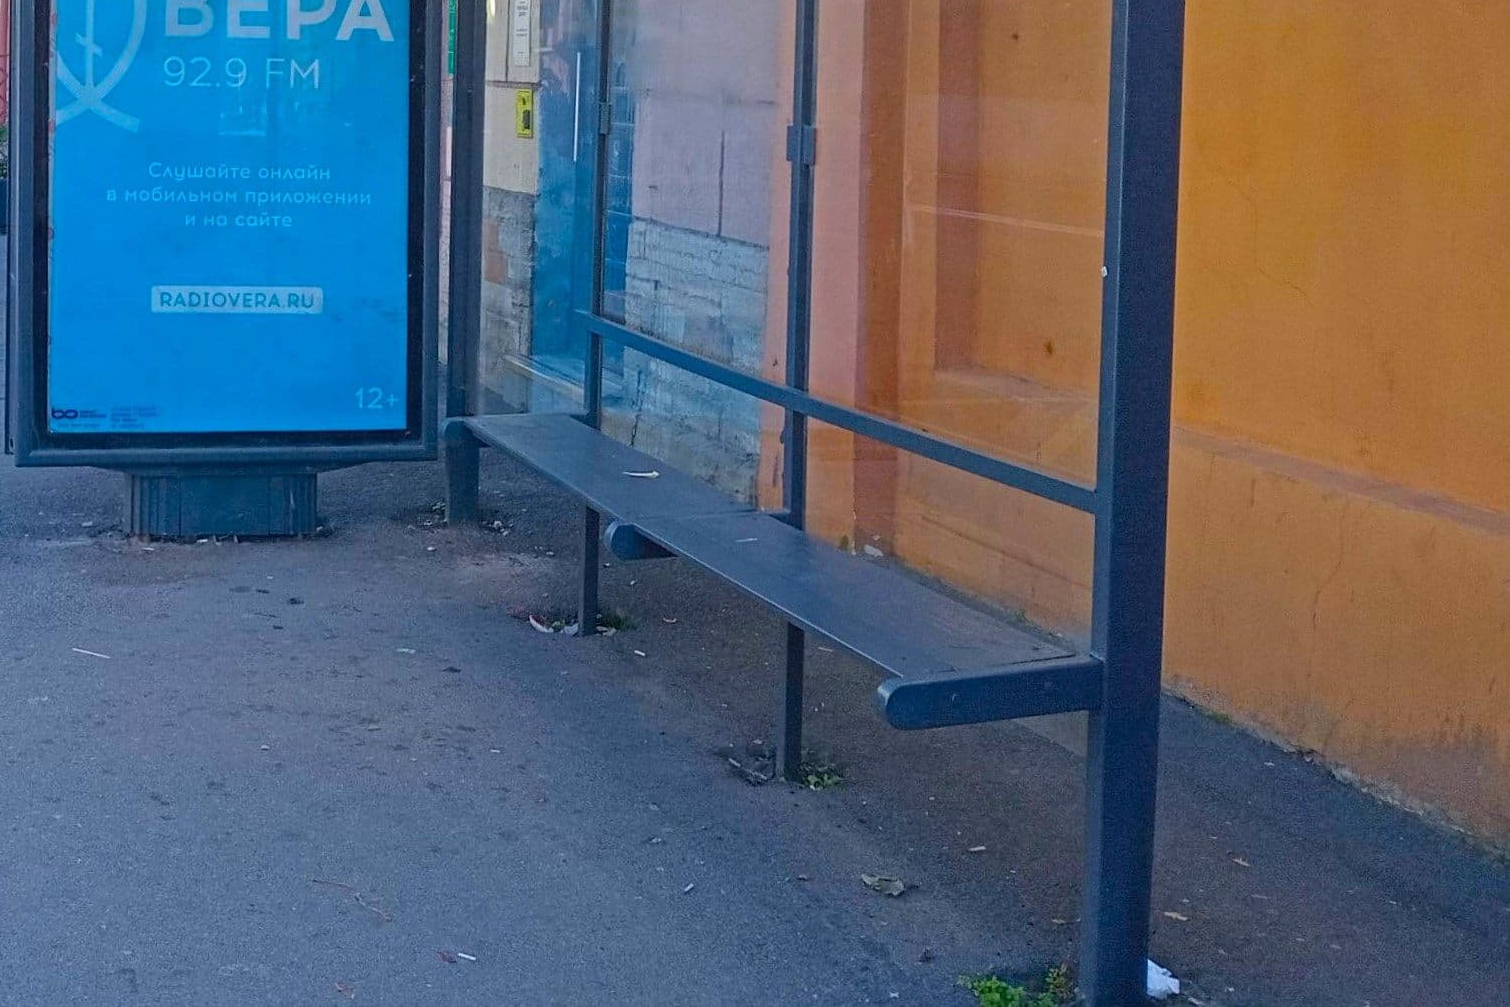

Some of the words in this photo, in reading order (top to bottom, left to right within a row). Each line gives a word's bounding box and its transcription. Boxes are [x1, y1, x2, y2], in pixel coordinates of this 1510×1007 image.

[163, 56, 247, 88] 92.9
[266, 57, 320, 89] FM
[148, 162, 251, 181] Слушайте
[258, 164, 331, 181] онлайн
[107, 189, 117, 202] в
[124, 186, 238, 203] мобильном
[245, 189, 372, 207] приложении
[185, 215, 196, 227] и
[204, 215, 228, 228] на
[234, 211, 293, 228] сайте
[159, 291, 314, 309] RADIOVERA.RU
[354, 387, 398, 410] 12+
